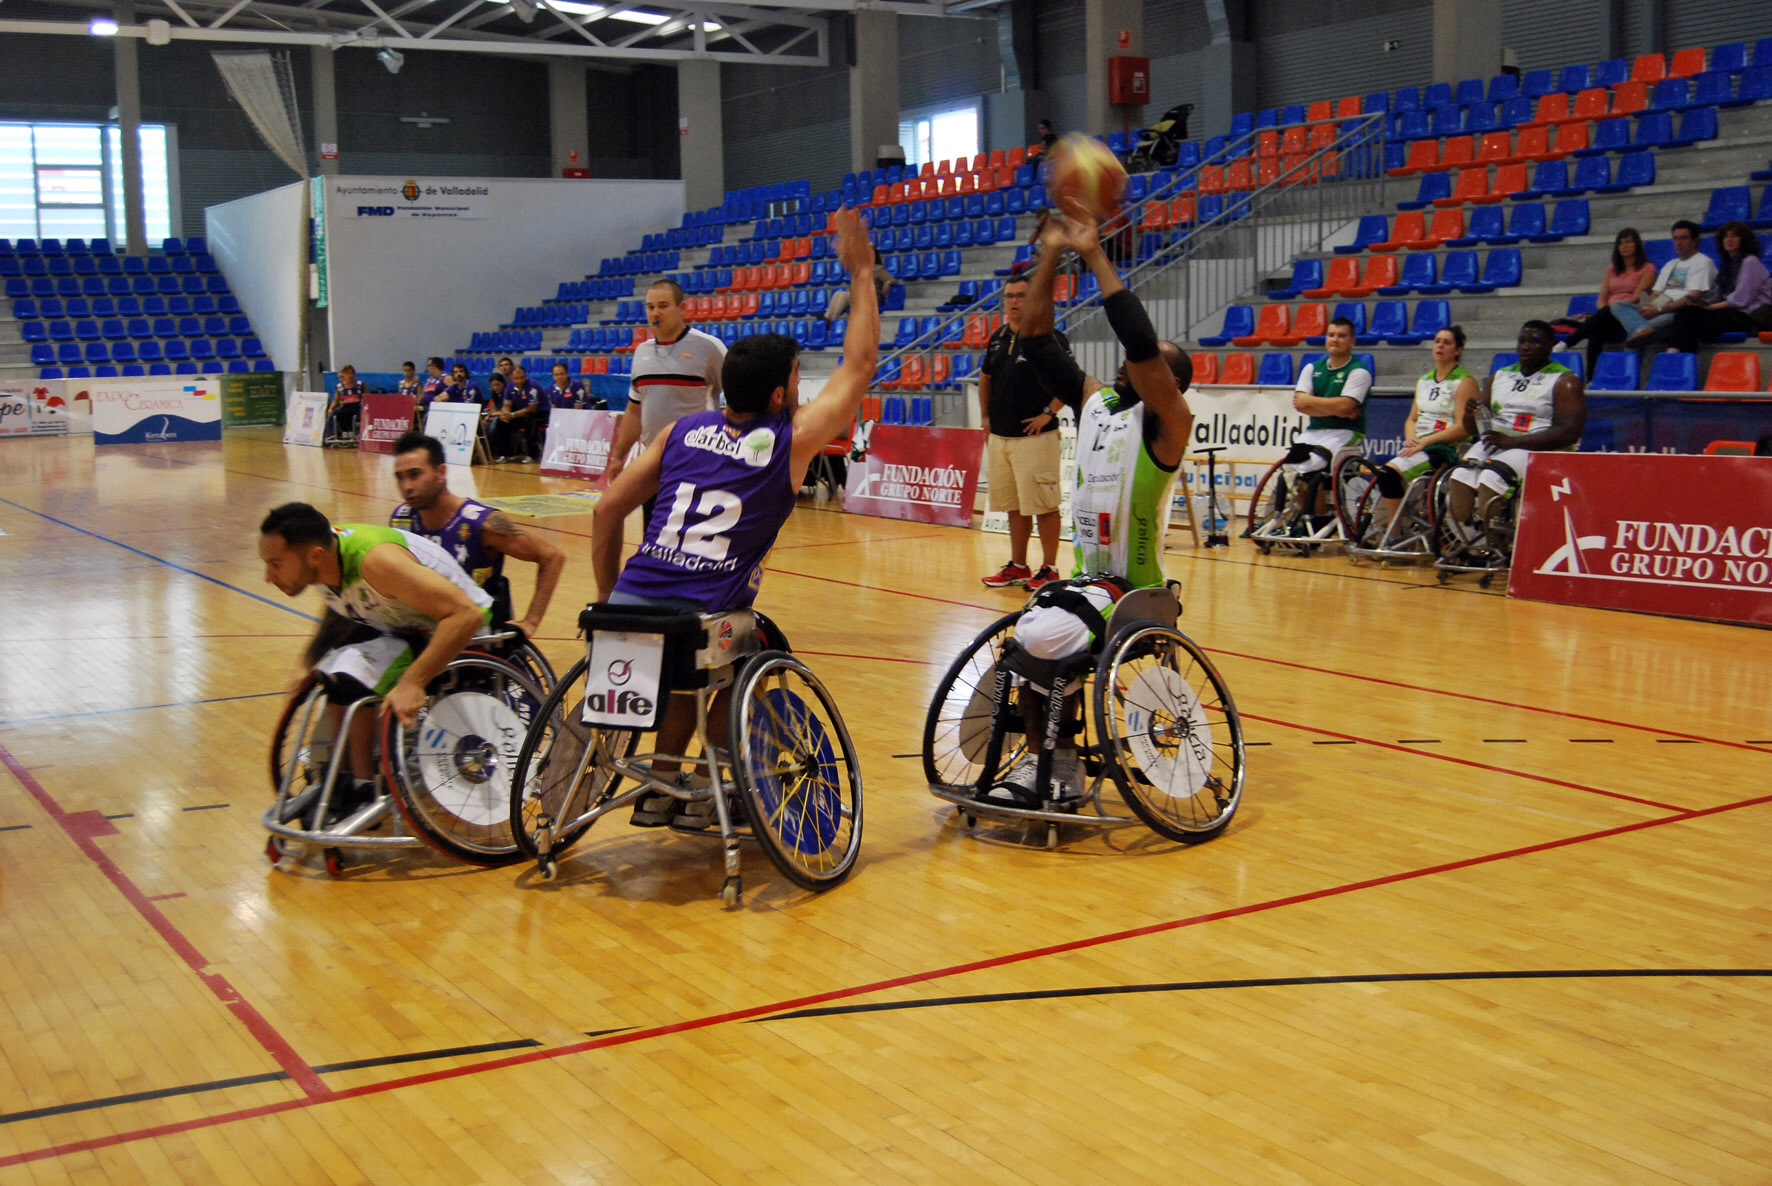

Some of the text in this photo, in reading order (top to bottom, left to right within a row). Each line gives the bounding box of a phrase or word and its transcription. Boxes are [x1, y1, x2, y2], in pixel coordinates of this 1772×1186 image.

[336, 186, 488, 196] Ayuntamiento de Valladolid
[357, 206, 394, 217] FMD
[1511, 379, 1530, 392] 18
[881, 463, 967, 489] FUNDACIÓN
[880, 482, 963, 504] GRUPO NORTE
[655, 481, 743, 562] 12
[1610, 552, 1772, 585] GRUPO NO
[587, 689, 653, 716] alfe
